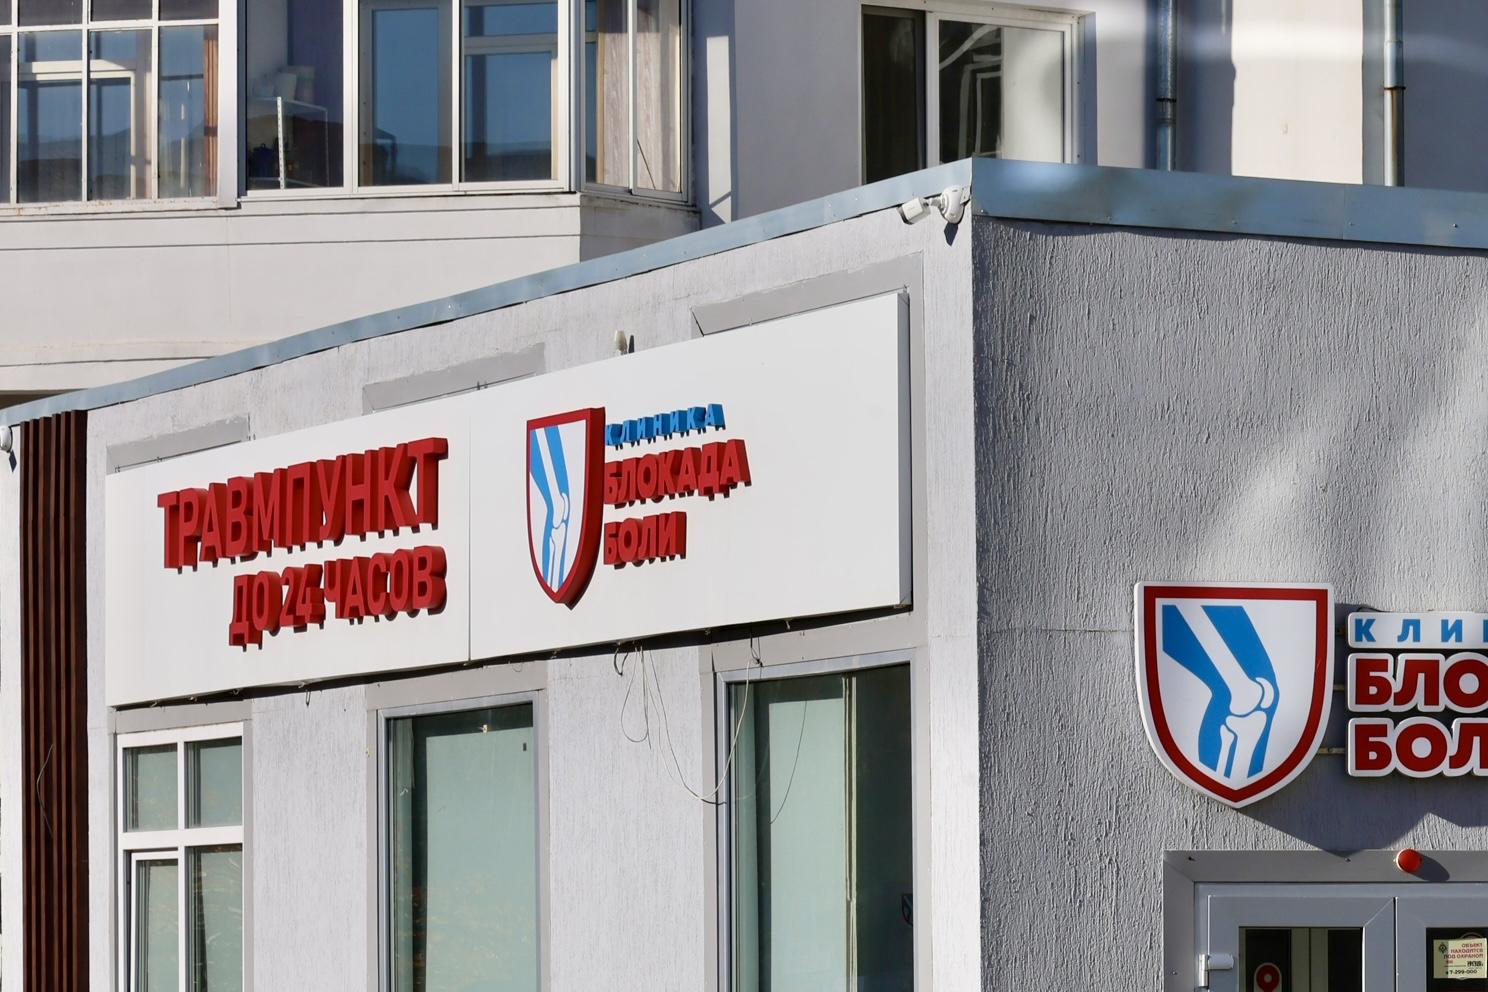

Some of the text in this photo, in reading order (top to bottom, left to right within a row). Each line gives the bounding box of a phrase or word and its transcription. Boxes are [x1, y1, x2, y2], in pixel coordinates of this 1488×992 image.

[605, 403, 725, 447] КЛИНИКА
[604, 439, 751, 503] БЛОКАДА
[157, 437, 449, 571] ТРАВМПУНКТ
[604, 511, 687, 566] БОЛИ
[229, 545, 447, 648] ДО 24 ЧАСОВ
